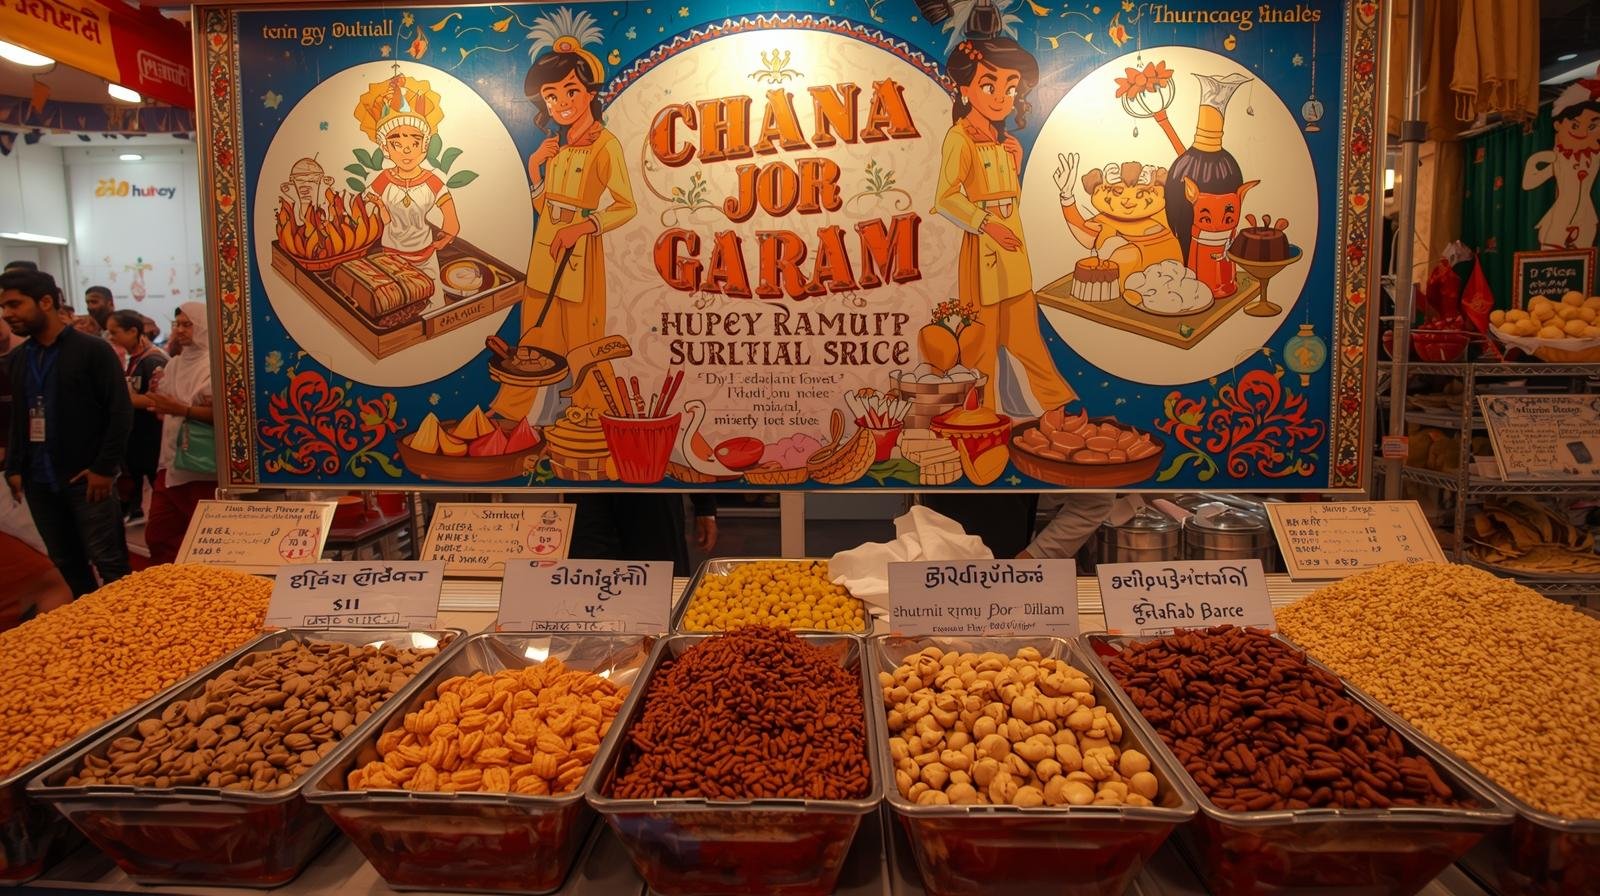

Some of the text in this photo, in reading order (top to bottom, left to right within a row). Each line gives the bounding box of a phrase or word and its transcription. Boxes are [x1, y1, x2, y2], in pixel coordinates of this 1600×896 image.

[649, 77, 921, 168] CHANA
[722, 157, 843, 224] JOR
[652, 211, 922, 301] GARAM
[823, 340, 910, 367] SRICE
[1023, 602, 1065, 616] Dillam
[1201, 602, 1244, 621] Barce
